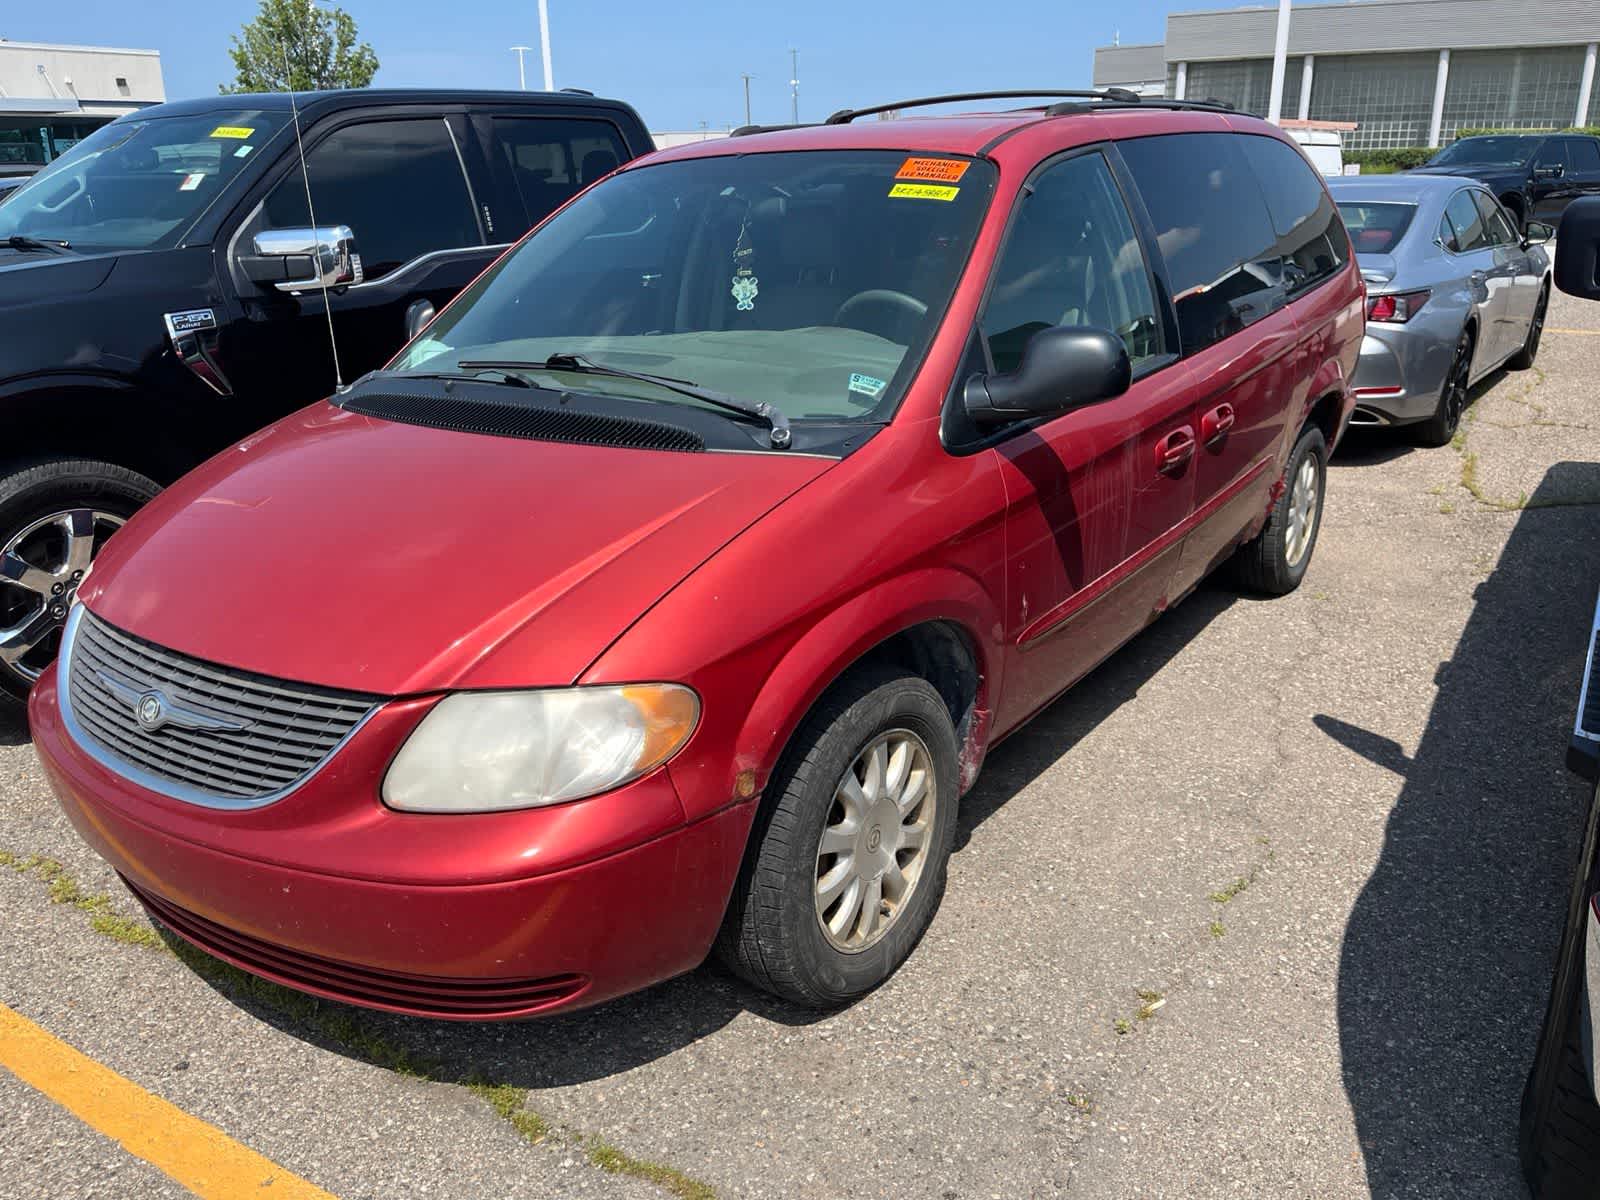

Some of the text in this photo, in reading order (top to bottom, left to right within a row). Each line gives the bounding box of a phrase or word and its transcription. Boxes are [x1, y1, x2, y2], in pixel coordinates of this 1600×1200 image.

[913, 160, 961, 168] MECHANICS
[916, 171, 959, 180] MANAGER
[172, 312, 212, 324] F-150
